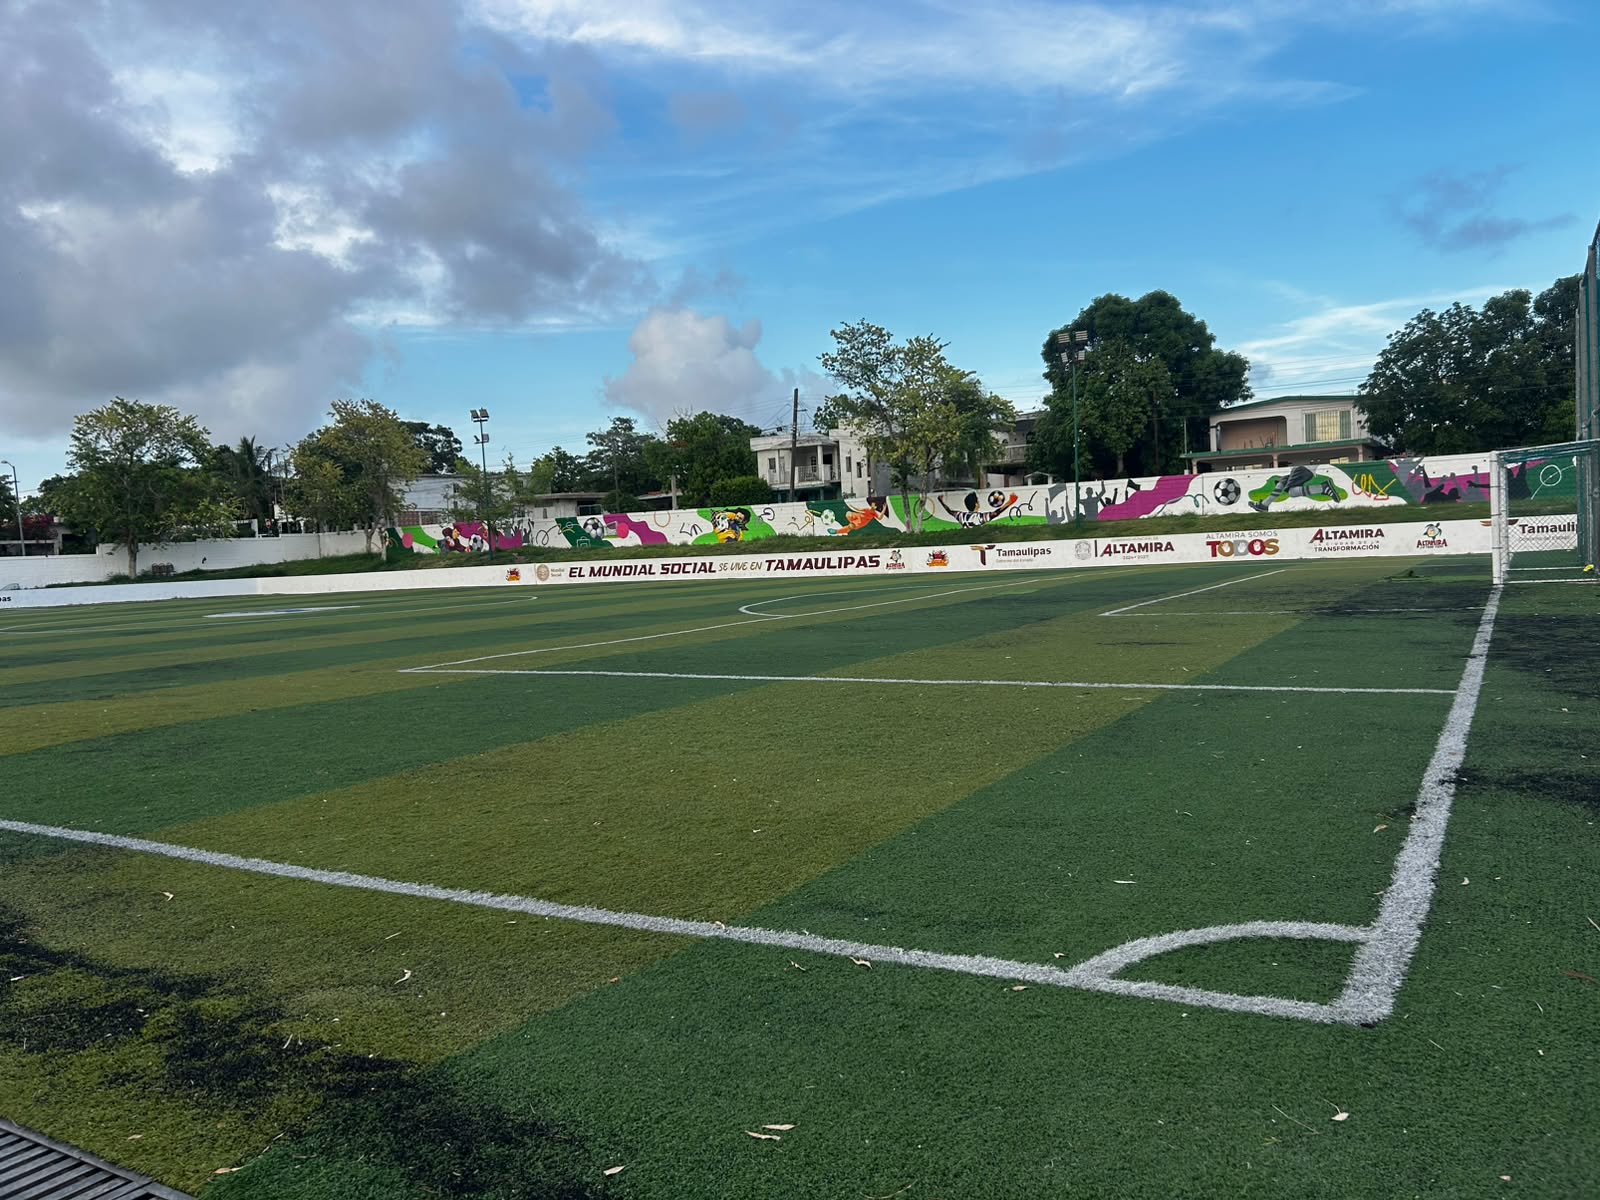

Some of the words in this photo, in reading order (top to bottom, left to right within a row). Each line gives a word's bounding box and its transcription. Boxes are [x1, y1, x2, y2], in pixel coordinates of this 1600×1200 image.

[1309, 528, 1385, 543] ALTAMIRA
[996, 547, 1052, 558] Tamaulipas
[1100, 541, 1175, 557] ALTAMIRA
[1206, 538, 1280, 557] TODOS
[1314, 543, 1380, 552] TRANSFORMACIÓN
[568, 567, 585, 578] EL
[588, 564, 656, 577] MUNDIAL
[660, 562, 716, 575] SOCIAL
[718, 562, 728, 571] SE
[750, 561, 762, 570] EN
[765, 555, 881, 571] TAMAULIPAS
